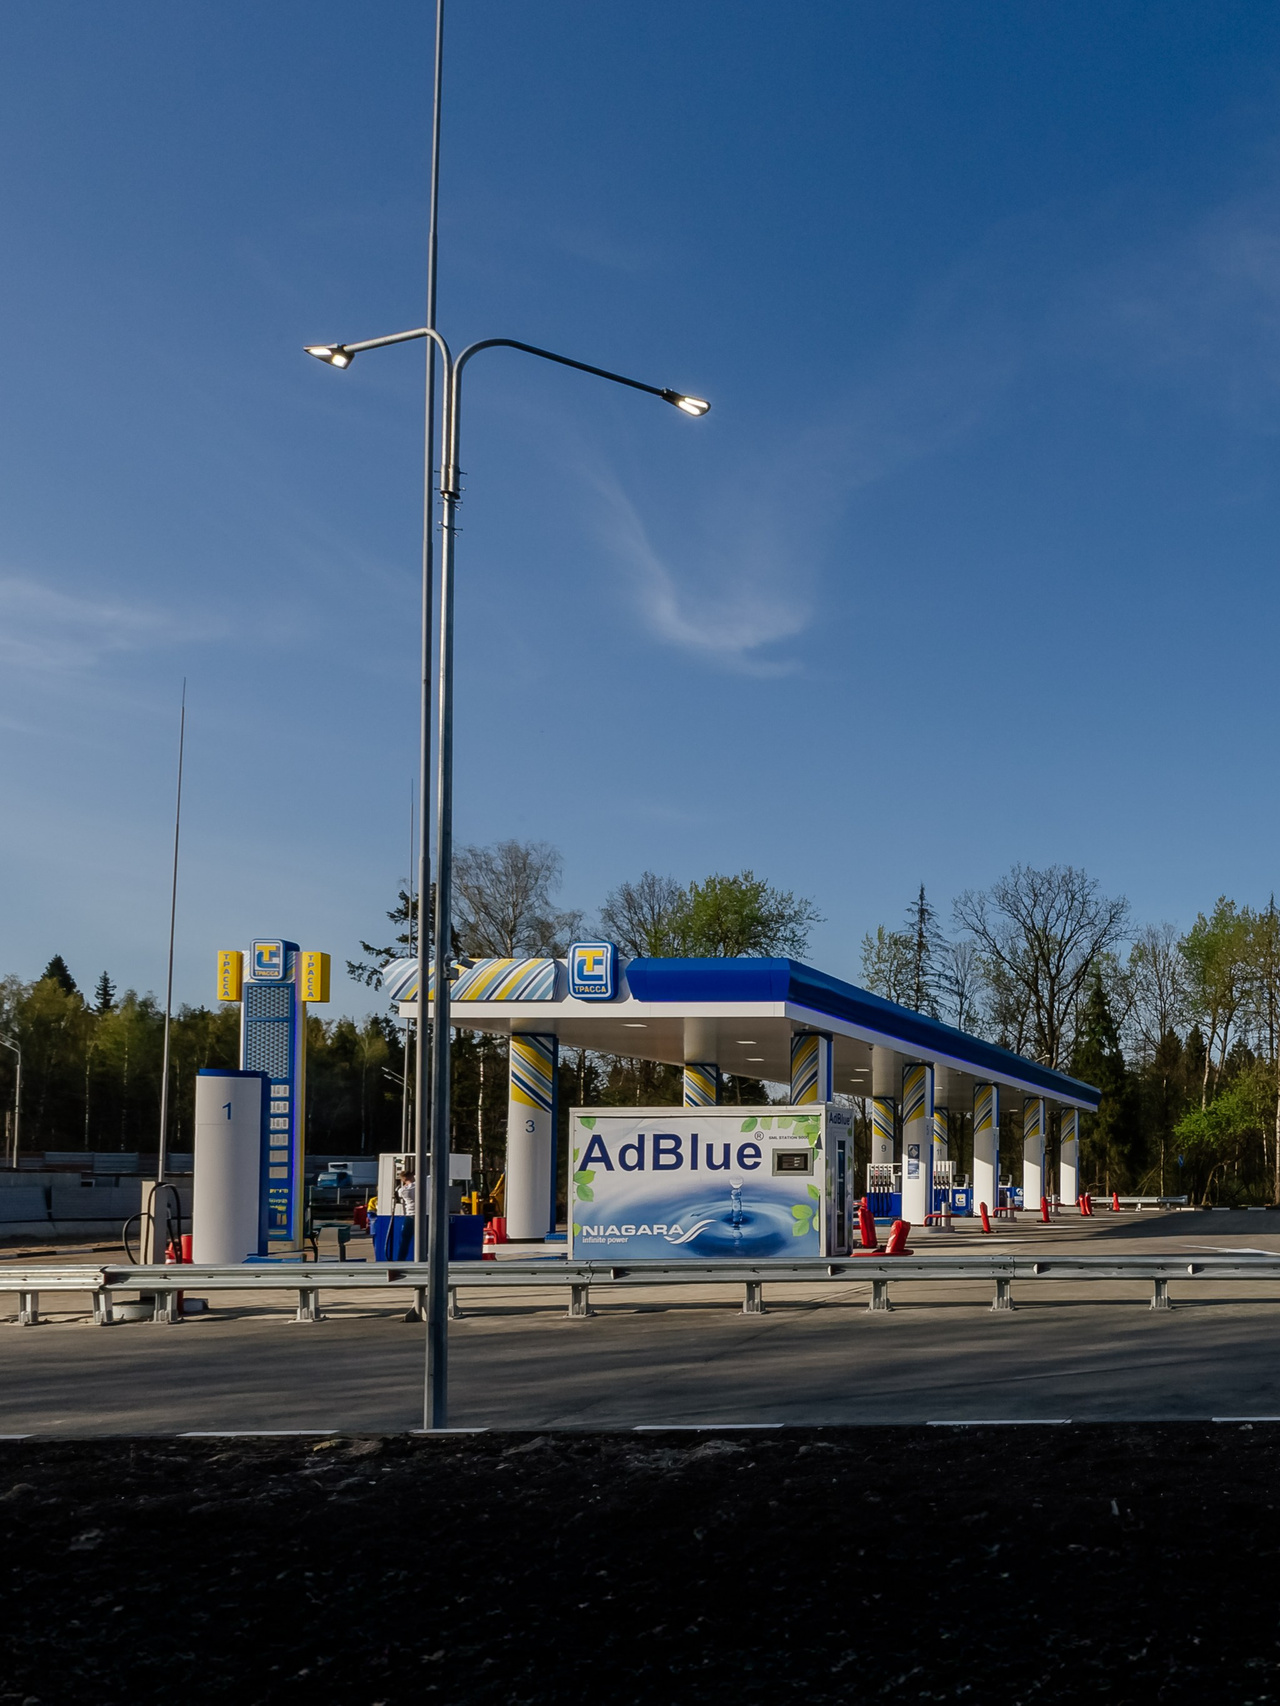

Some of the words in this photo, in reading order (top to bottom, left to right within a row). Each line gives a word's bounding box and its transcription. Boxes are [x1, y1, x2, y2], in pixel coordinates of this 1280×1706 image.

[307, 955, 315, 997] ТРАССА
[222, 1102, 232, 1120] 1
[829, 1112, 850, 1125] AdBlue
[525, 1120, 535, 1133] 3
[578, 1133, 762, 1171] AdBlue
[881, 1144, 887, 1153] 9
[582, 1224, 684, 1236] NIAGARA
[582, 1236, 606, 1244] infinite
[607, 1237, 629, 1245] power
